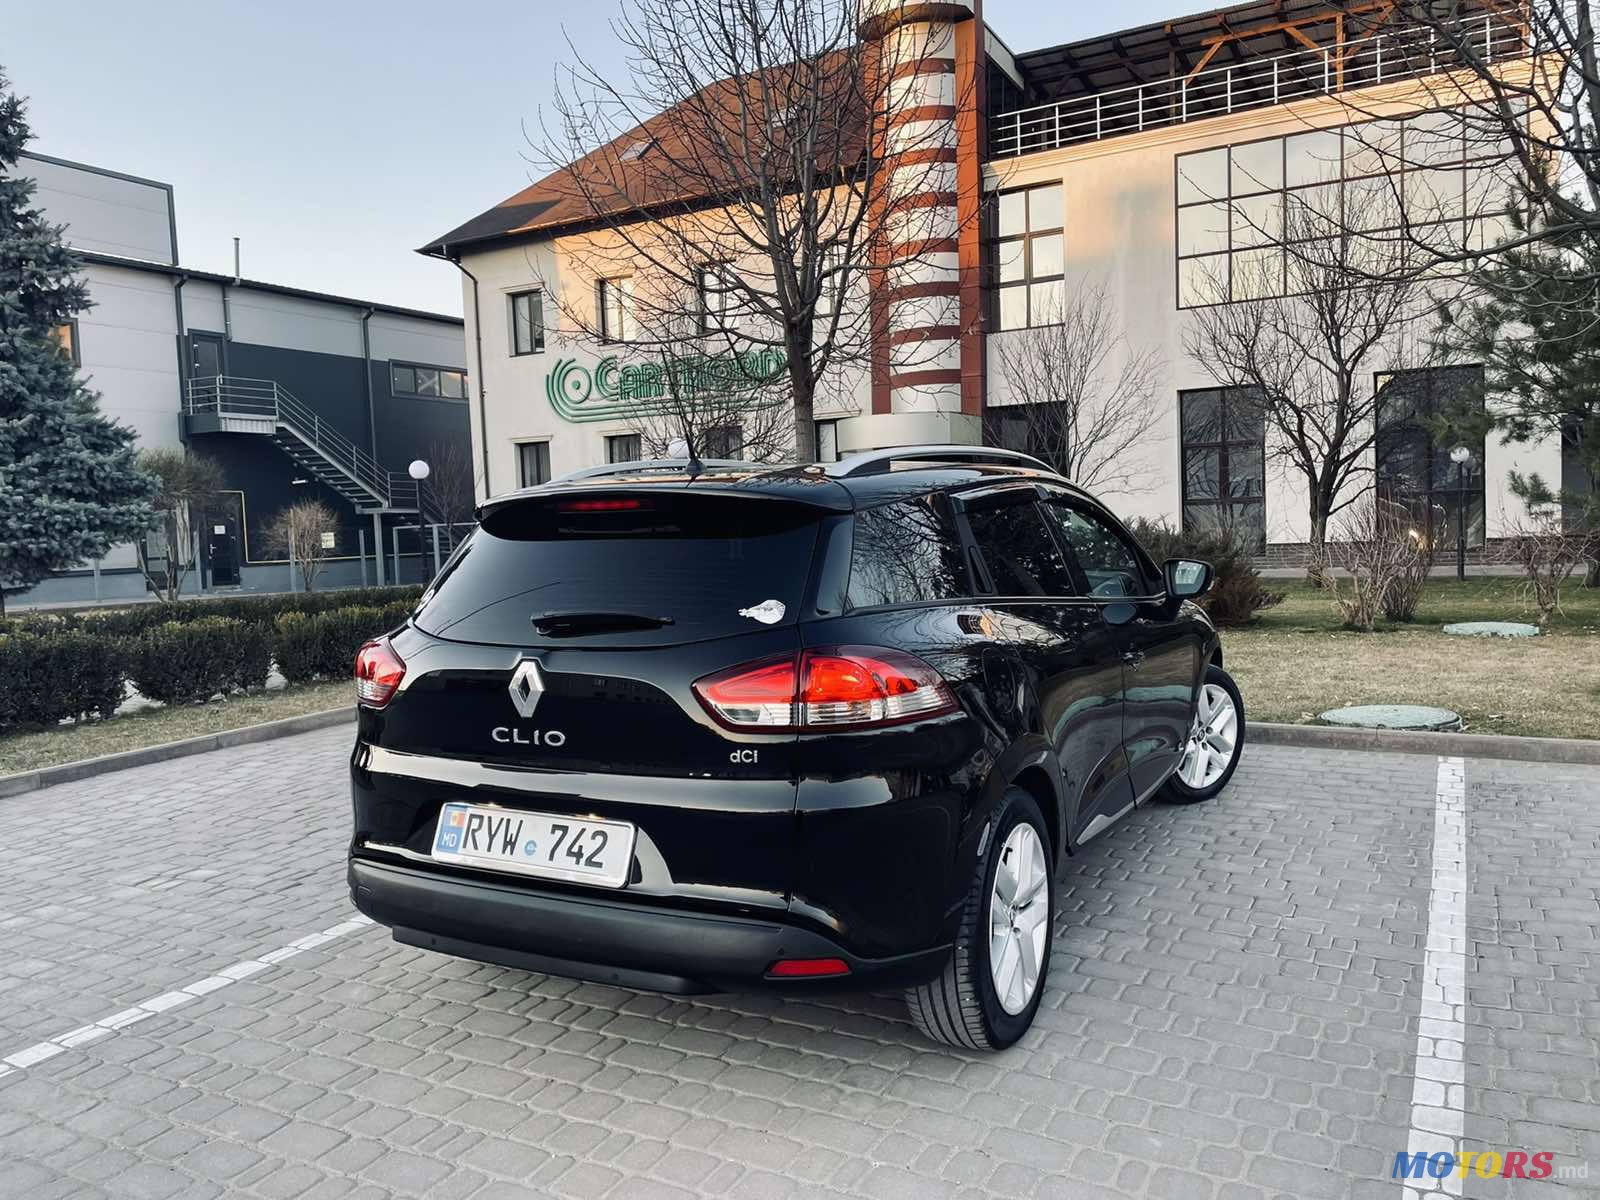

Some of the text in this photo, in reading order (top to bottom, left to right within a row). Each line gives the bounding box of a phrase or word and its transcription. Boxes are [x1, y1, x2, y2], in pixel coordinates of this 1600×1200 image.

[491, 726, 566, 747] CLIO
[729, 750, 758, 764] dCi
[441, 832, 457, 848] MD
[462, 813, 609, 869] RYW 742
